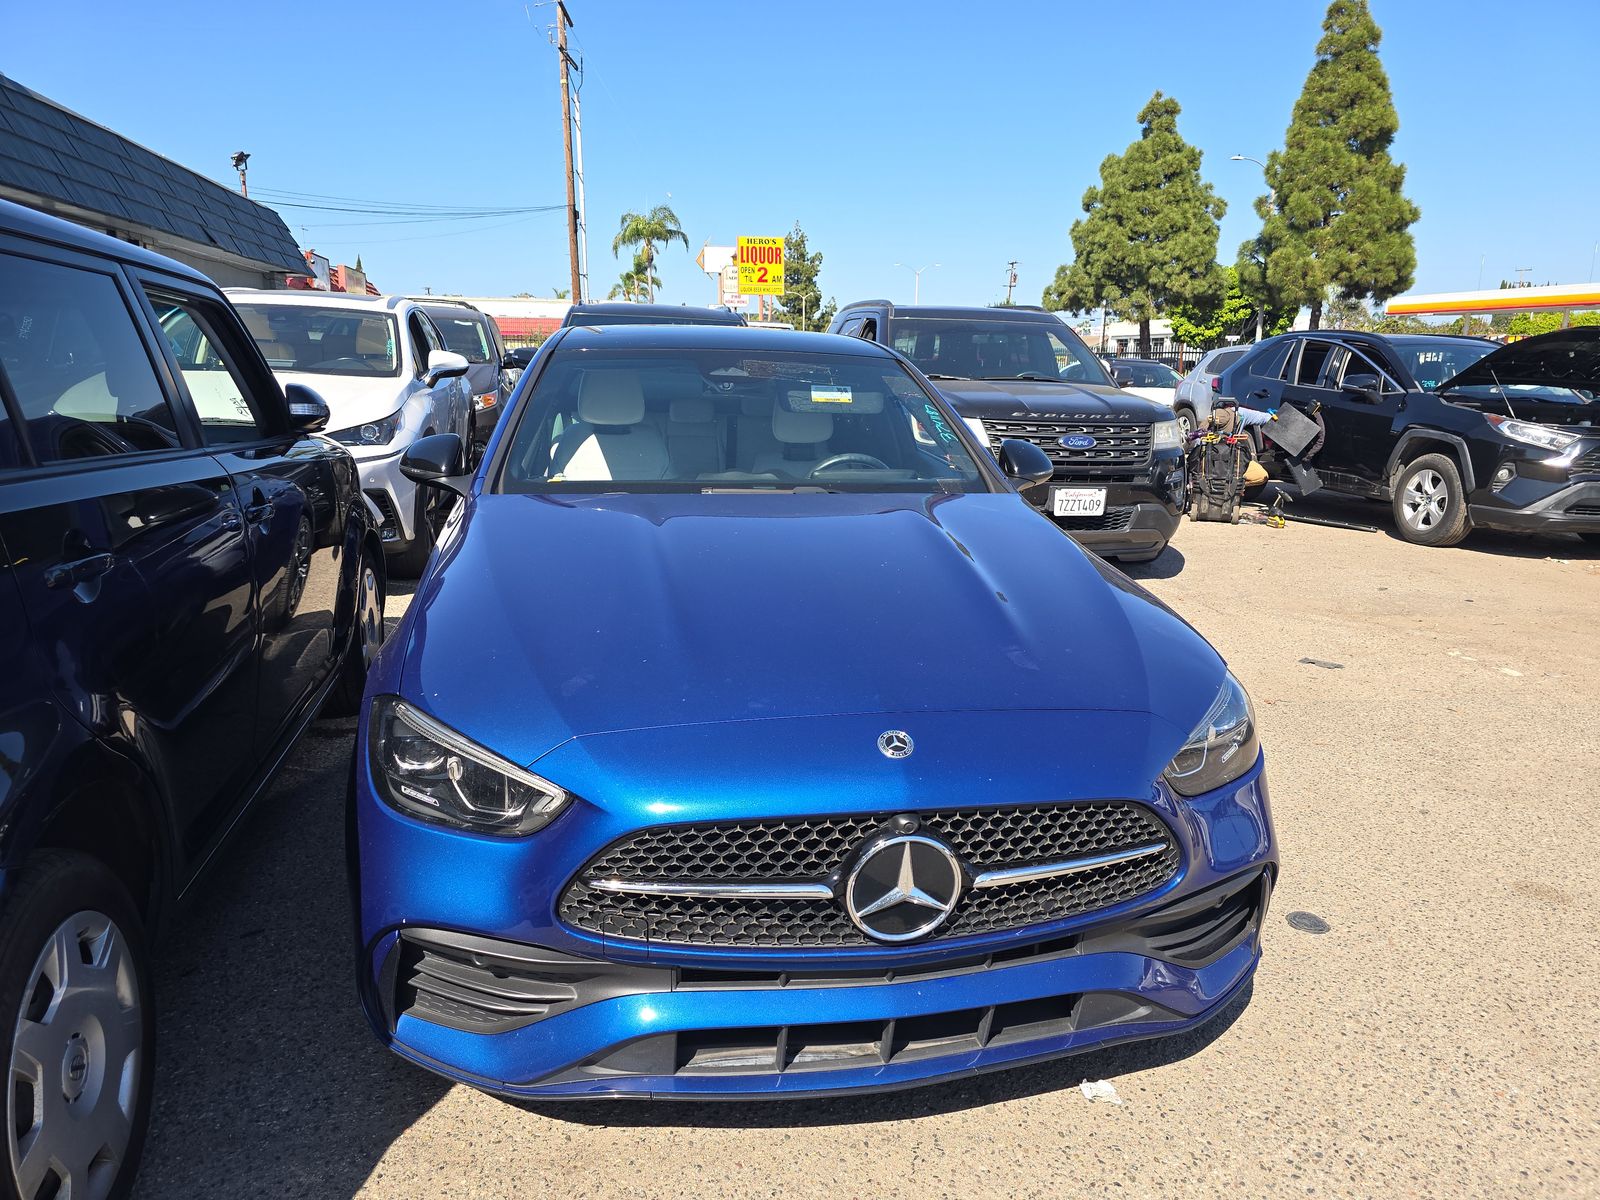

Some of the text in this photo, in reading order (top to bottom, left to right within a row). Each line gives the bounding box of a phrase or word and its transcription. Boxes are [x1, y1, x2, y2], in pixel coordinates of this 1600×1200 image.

[740, 245, 782, 265] LIQUOR
[740, 266, 755, 274] OPEN
[757, 266, 768, 283] 2
[771, 275, 782, 283] AM
[1012, 411, 1130, 419] EXPLORER
[1067, 436, 1089, 447] Ford
[1064, 491, 1095, 499] California
[1058, 499, 1102, 512] 7ZZT409
